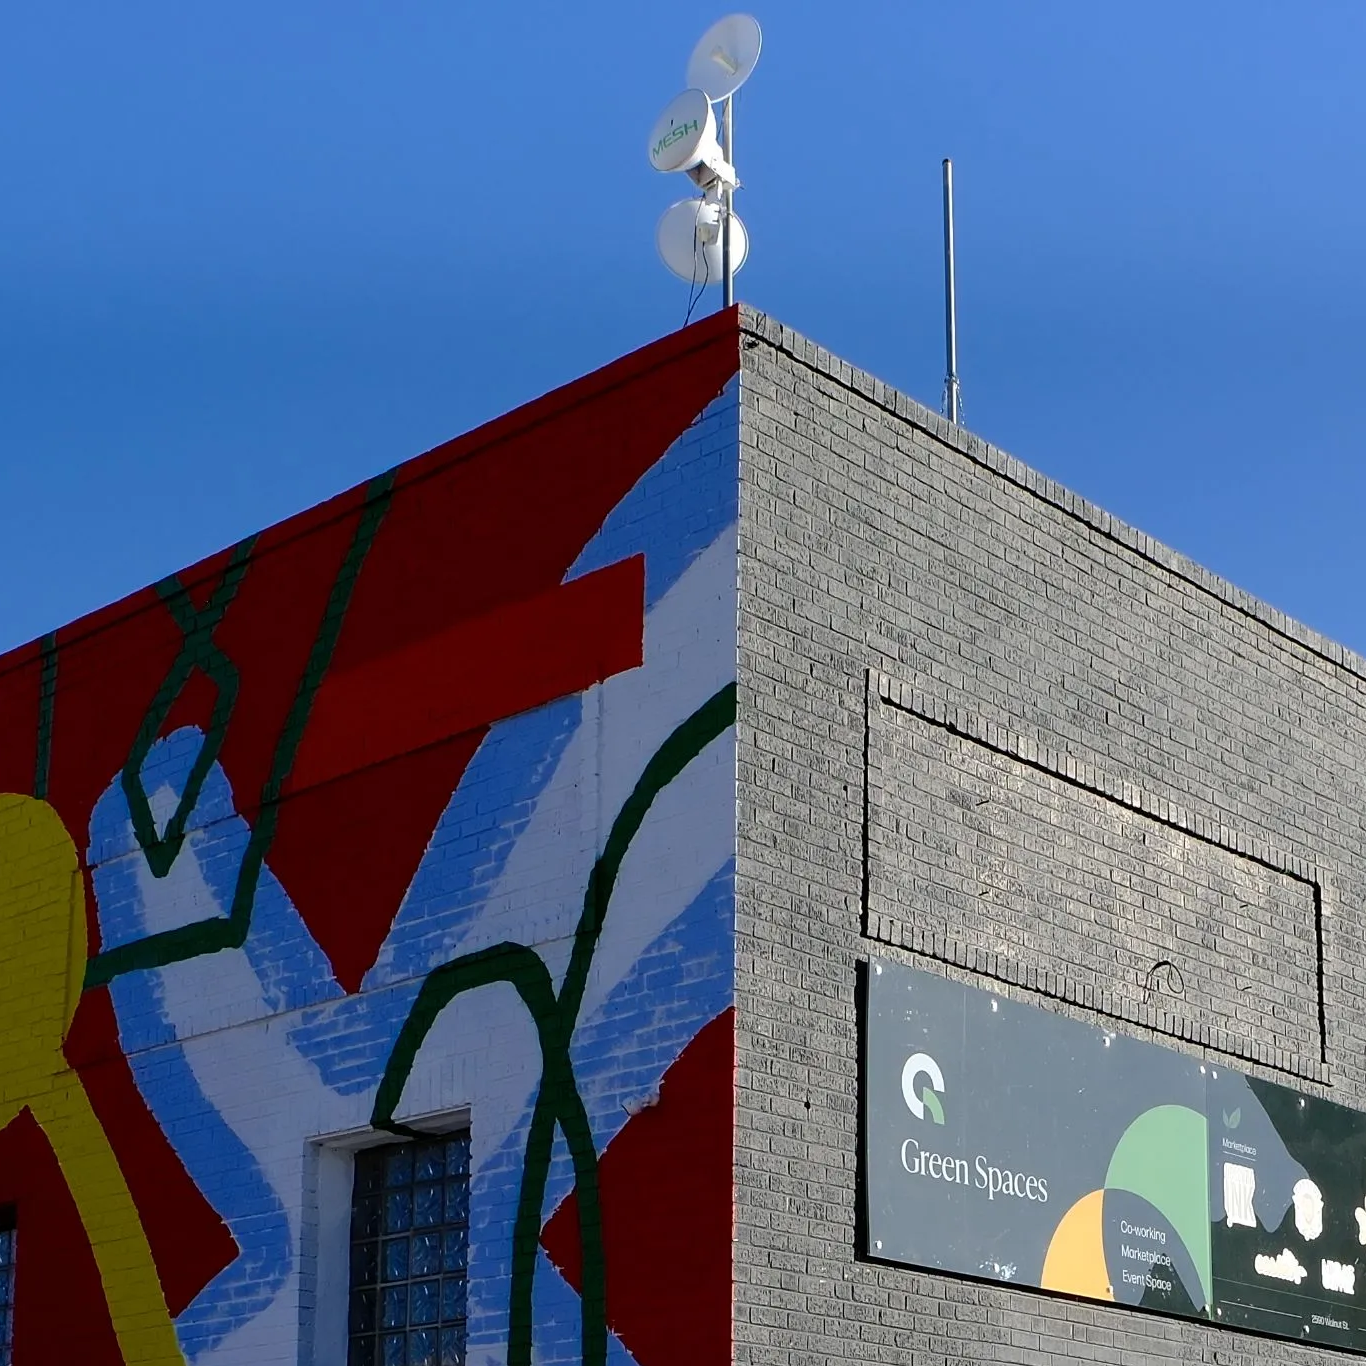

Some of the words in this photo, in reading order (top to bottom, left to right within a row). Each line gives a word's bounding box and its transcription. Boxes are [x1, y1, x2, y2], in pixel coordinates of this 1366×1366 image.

[652, 119, 698, 160] MESH
[901, 1138, 970, 1186] Green
[974, 1155, 1049, 1203] Spaces
[1120, 1220, 1166, 1245] Co-working
[1121, 1244, 1171, 1267] Marketplace
[1122, 1269, 1146, 1287] Event
[1145, 1274, 1172, 1292] Space
